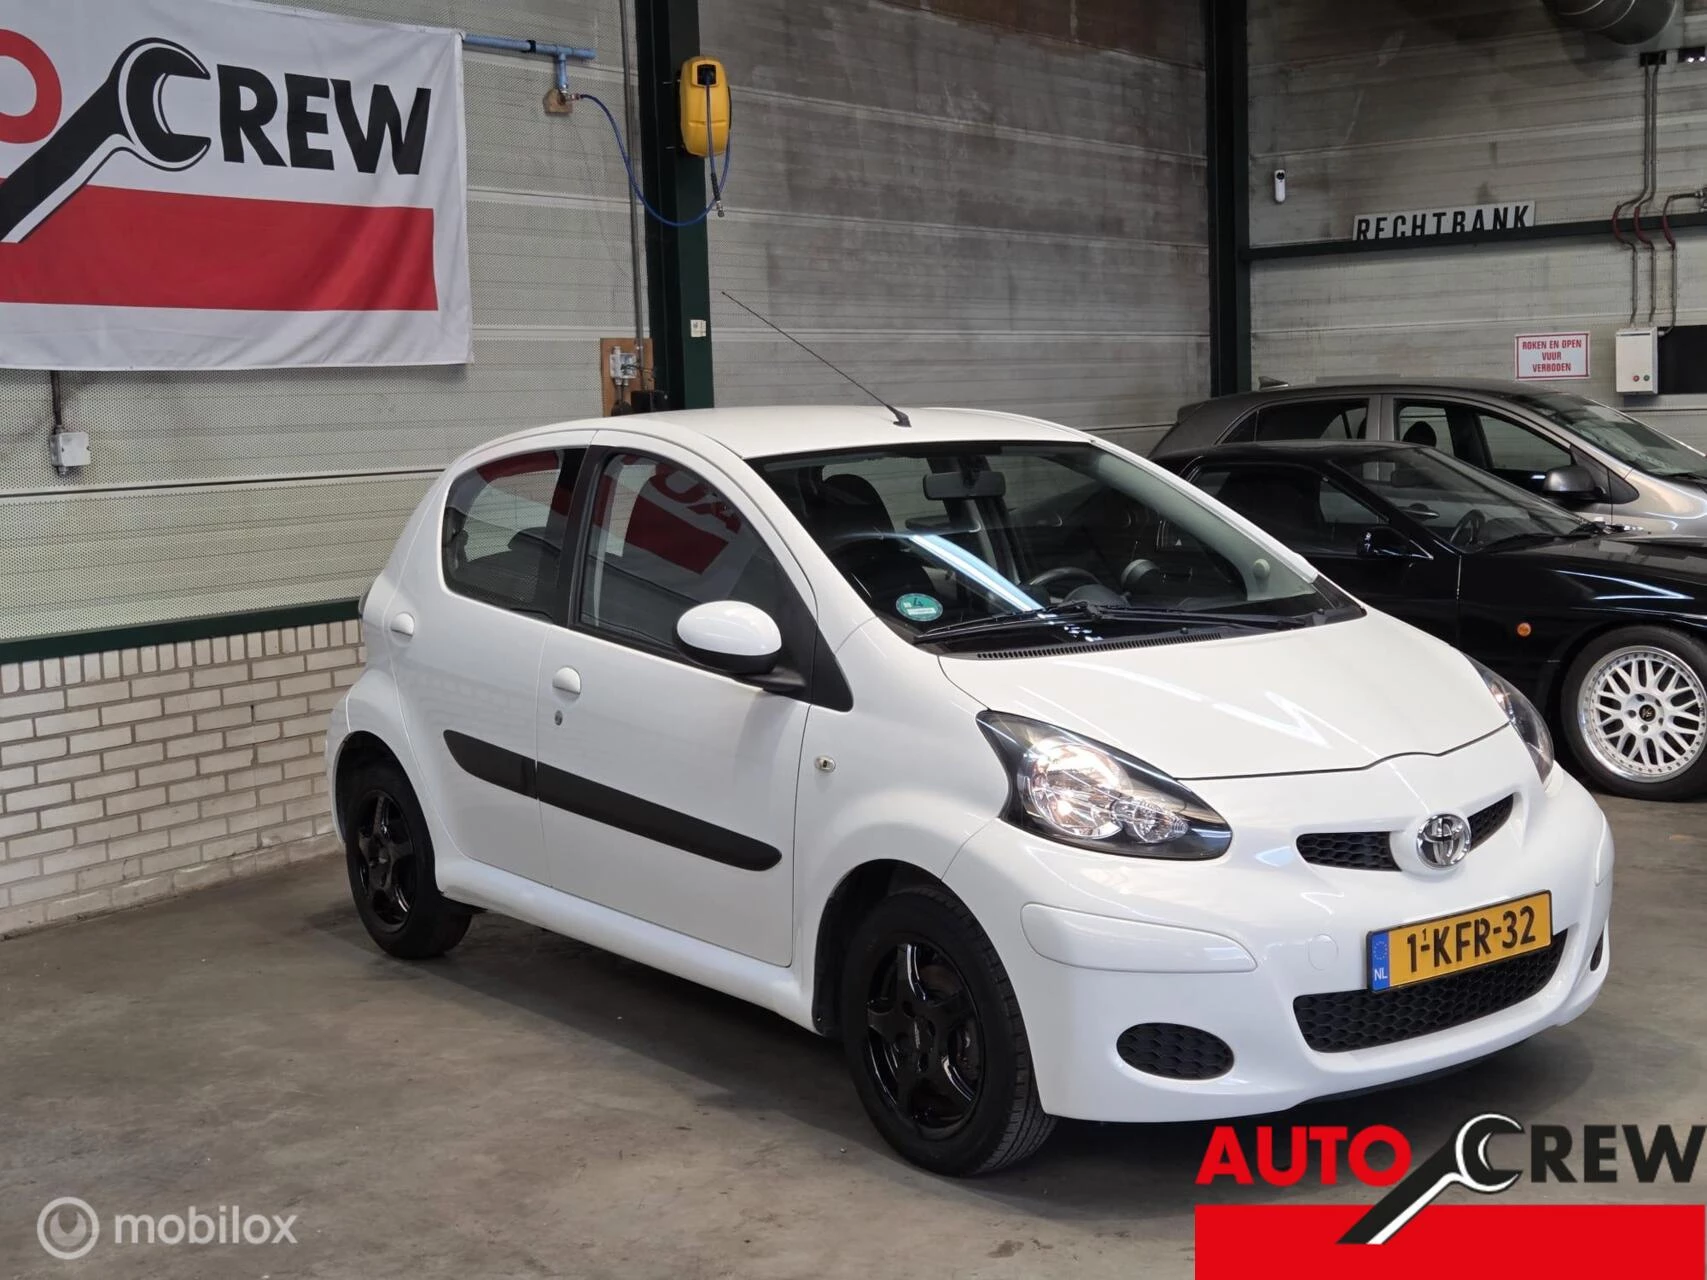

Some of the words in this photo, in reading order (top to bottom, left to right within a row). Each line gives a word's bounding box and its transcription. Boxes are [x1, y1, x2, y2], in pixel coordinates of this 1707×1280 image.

[118, 37, 432, 175] CREW
[1522, 340, 1547, 350] ROKEN
[1549, 340, 1559, 349] EN
[1562, 339, 1582, 348] OPEN
[1542, 351, 1562, 361] VUUR
[1532, 362, 1571, 373] VERBODEN
[1374, 968, 1388, 981] NL
